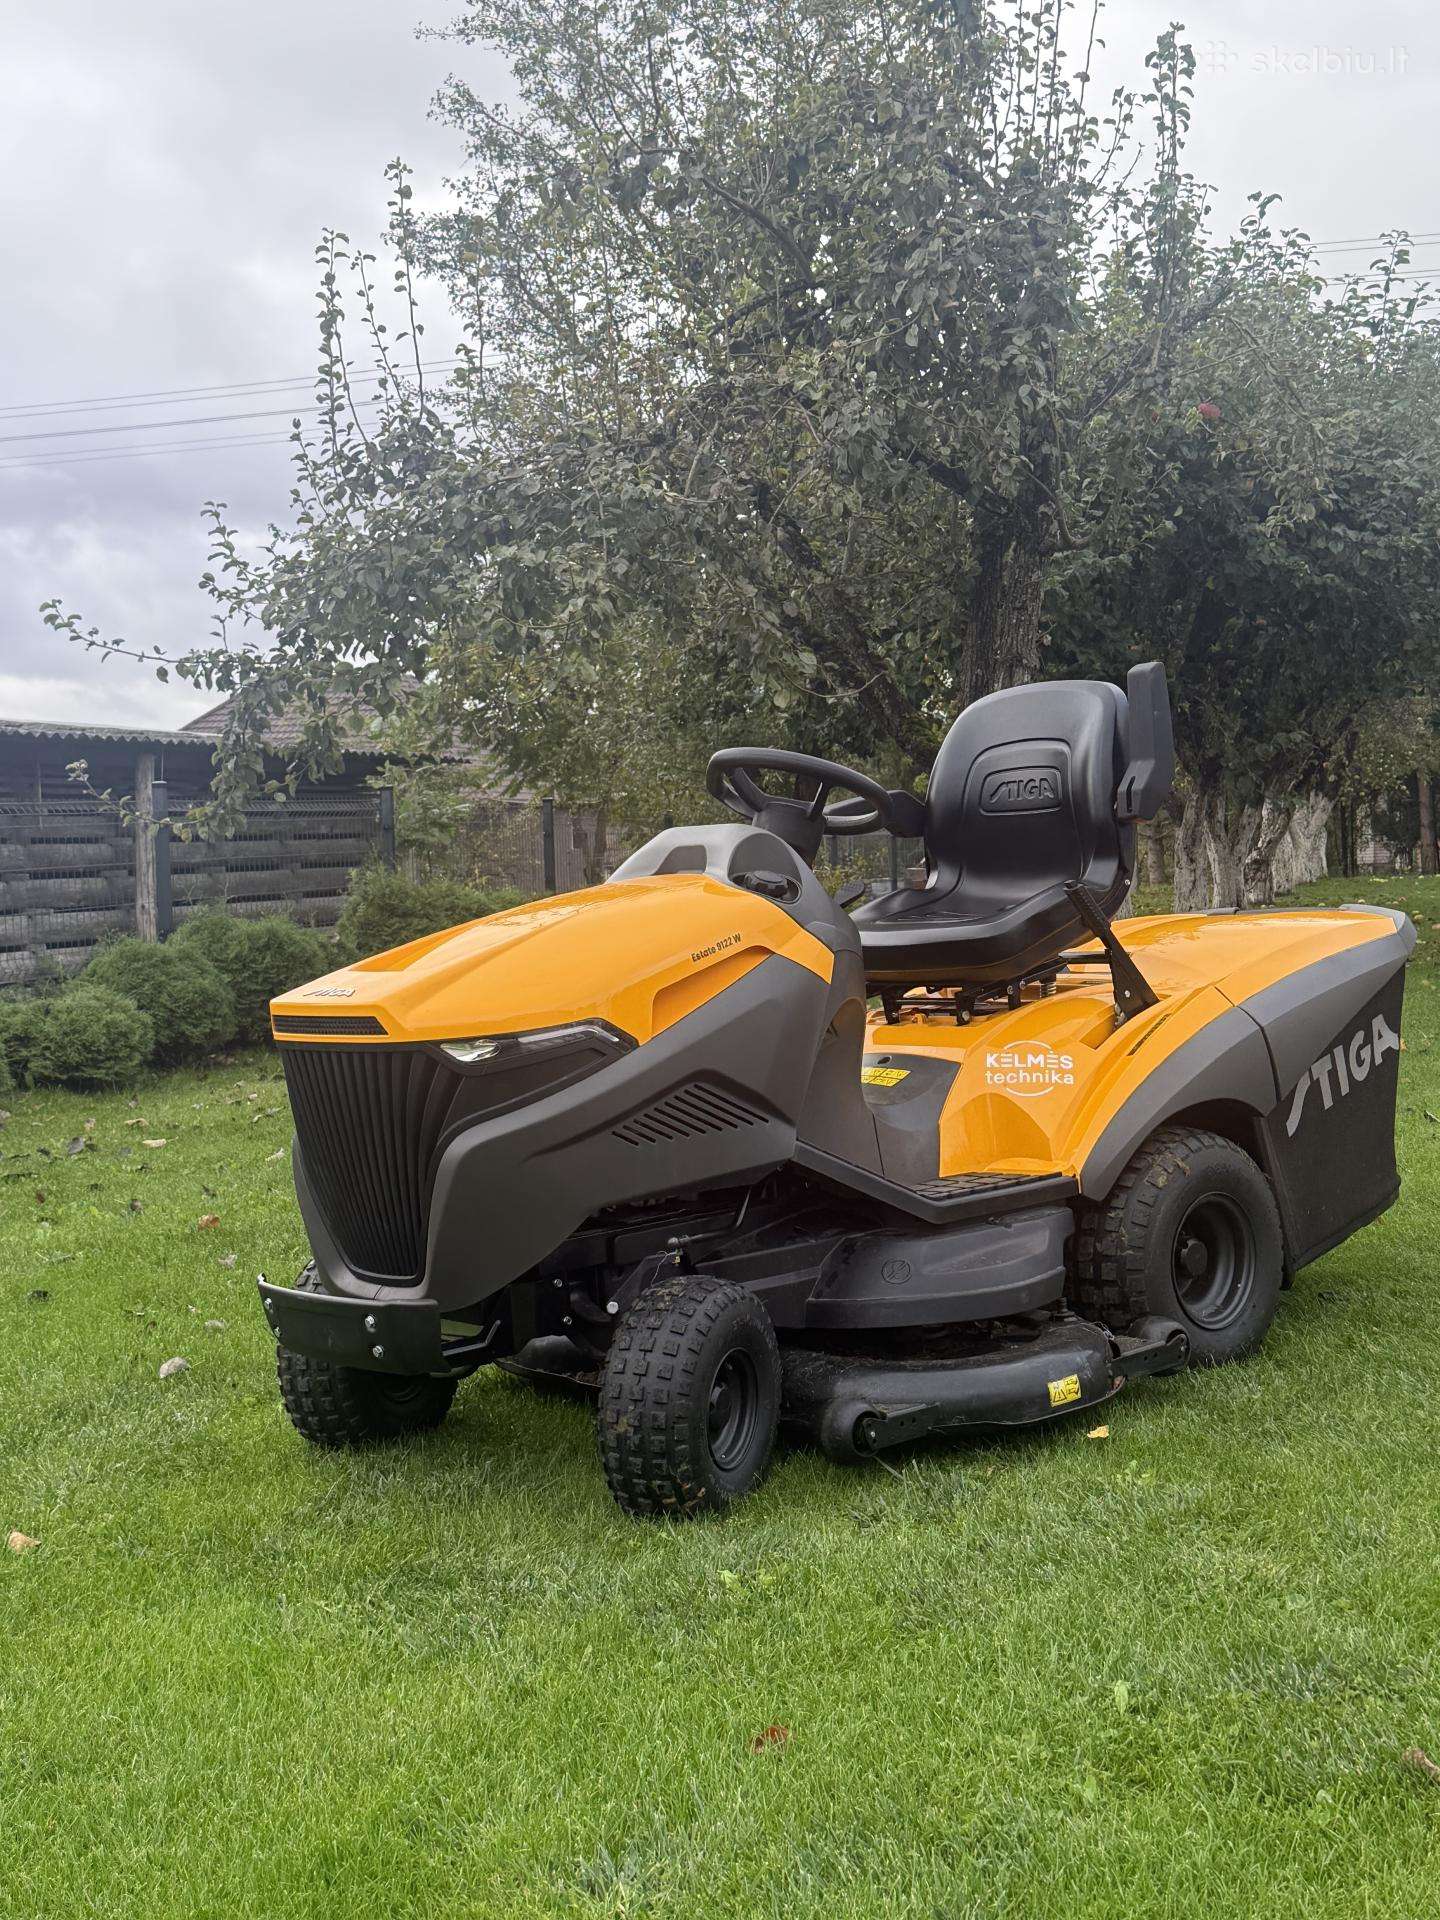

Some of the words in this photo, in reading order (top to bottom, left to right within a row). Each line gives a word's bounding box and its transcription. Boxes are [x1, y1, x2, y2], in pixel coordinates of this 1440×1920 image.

[990, 778, 1054, 803] STIGA
[691, 946, 716, 962] Estate
[716, 936, 733, 950] 9122
[732, 933, 741, 943] W
[986, 1051, 1073, 1069] KELMĖS
[985, 1069, 1074, 1085] technika
[1286, 1013, 1400, 1138] STIGA
